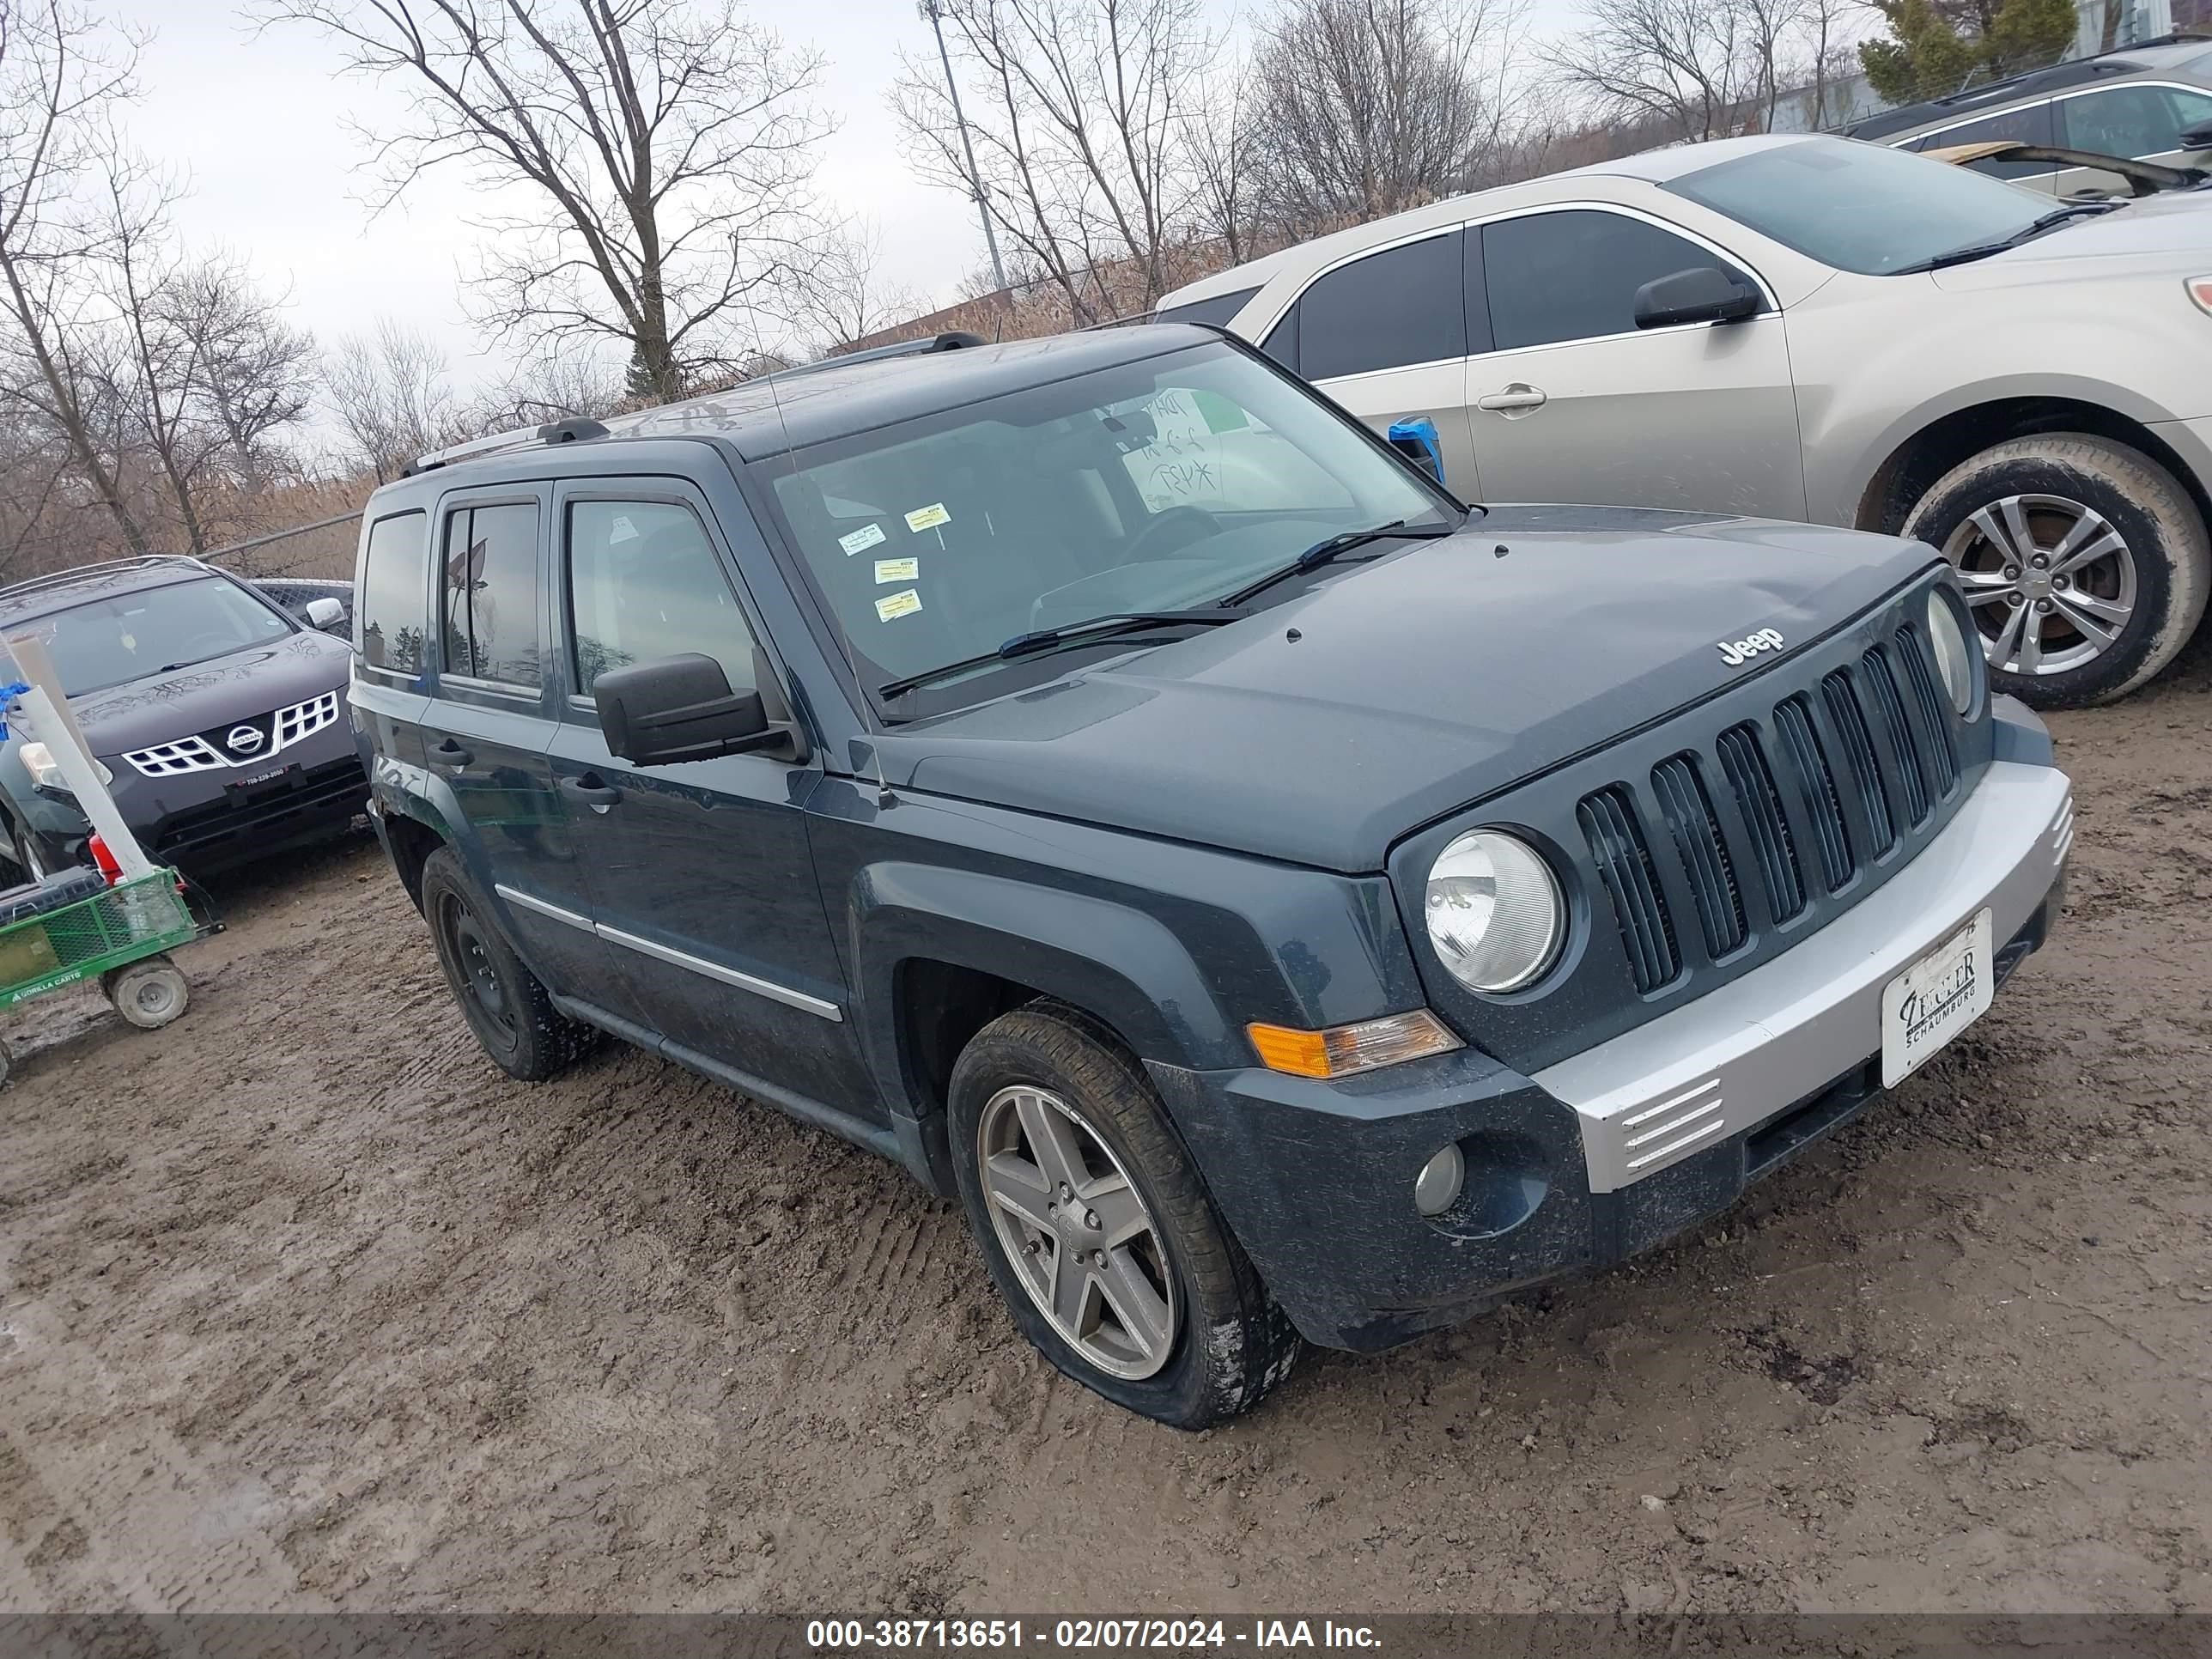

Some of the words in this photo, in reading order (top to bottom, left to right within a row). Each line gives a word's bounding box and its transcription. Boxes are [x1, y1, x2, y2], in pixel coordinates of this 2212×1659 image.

[1717, 628, 1784, 665] Jeep
[231, 733, 261, 745] NISSAN
[21, 981, 54, 998] GORILLA
[54, 972, 82, 986] CARTS
[1905, 986, 1976, 1049] SCHAUMBURG
